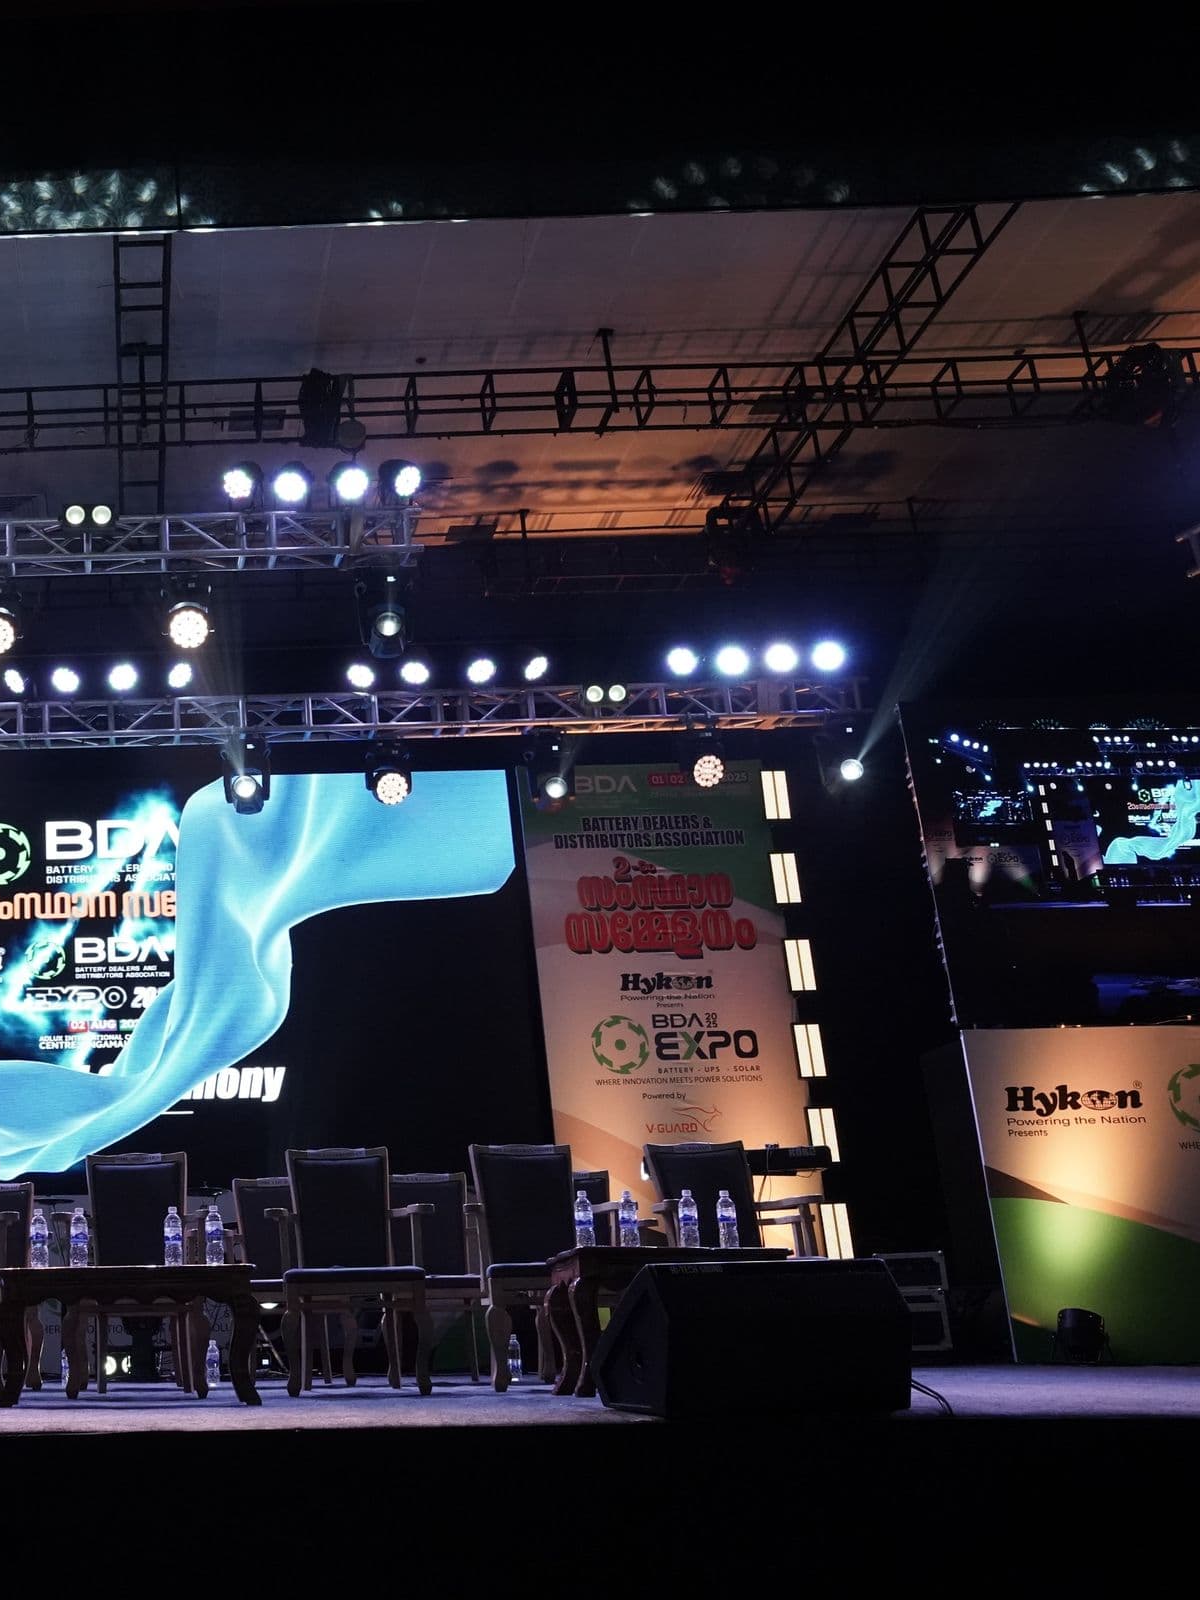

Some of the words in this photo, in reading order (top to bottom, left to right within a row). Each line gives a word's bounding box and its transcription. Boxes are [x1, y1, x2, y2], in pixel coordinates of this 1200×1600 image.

[583, 816, 638, 831] BATTERY
[643, 815, 699, 830] DEALERS
[702, 816, 713, 829] &
[45, 819, 179, 860] BDA
[554, 833, 651, 849] DISTRIBUTORS
[655, 831, 745, 847] ASSOCIATION
[46, 865, 94, 874] BATTERY
[74, 936, 170, 964] BDA
[620, 972, 713, 994] Hykon
[131, 986, 162, 1008] 20
[90, 1020, 117, 1030] AUG
[652, 1013, 703, 1029] BDA
[39, 1040, 78, 1050] CENTRE
[655, 1030, 759, 1060] EXPO
[596, 1078, 620, 1086] WHERE
[622, 1077, 668, 1085] INNOVATION
[669, 1076, 693, 1084] MEETS
[677, 1092, 686, 1101] by
[1005, 1085, 1143, 1117] Hykon
[1007, 1117, 1070, 1127] Powering
[1075, 1117, 1096, 1125] the
[1101, 1116, 1146, 1124] Nation
[1008, 1129, 1048, 1137] Presents
[1179, 1142, 1200, 1150] WHE
